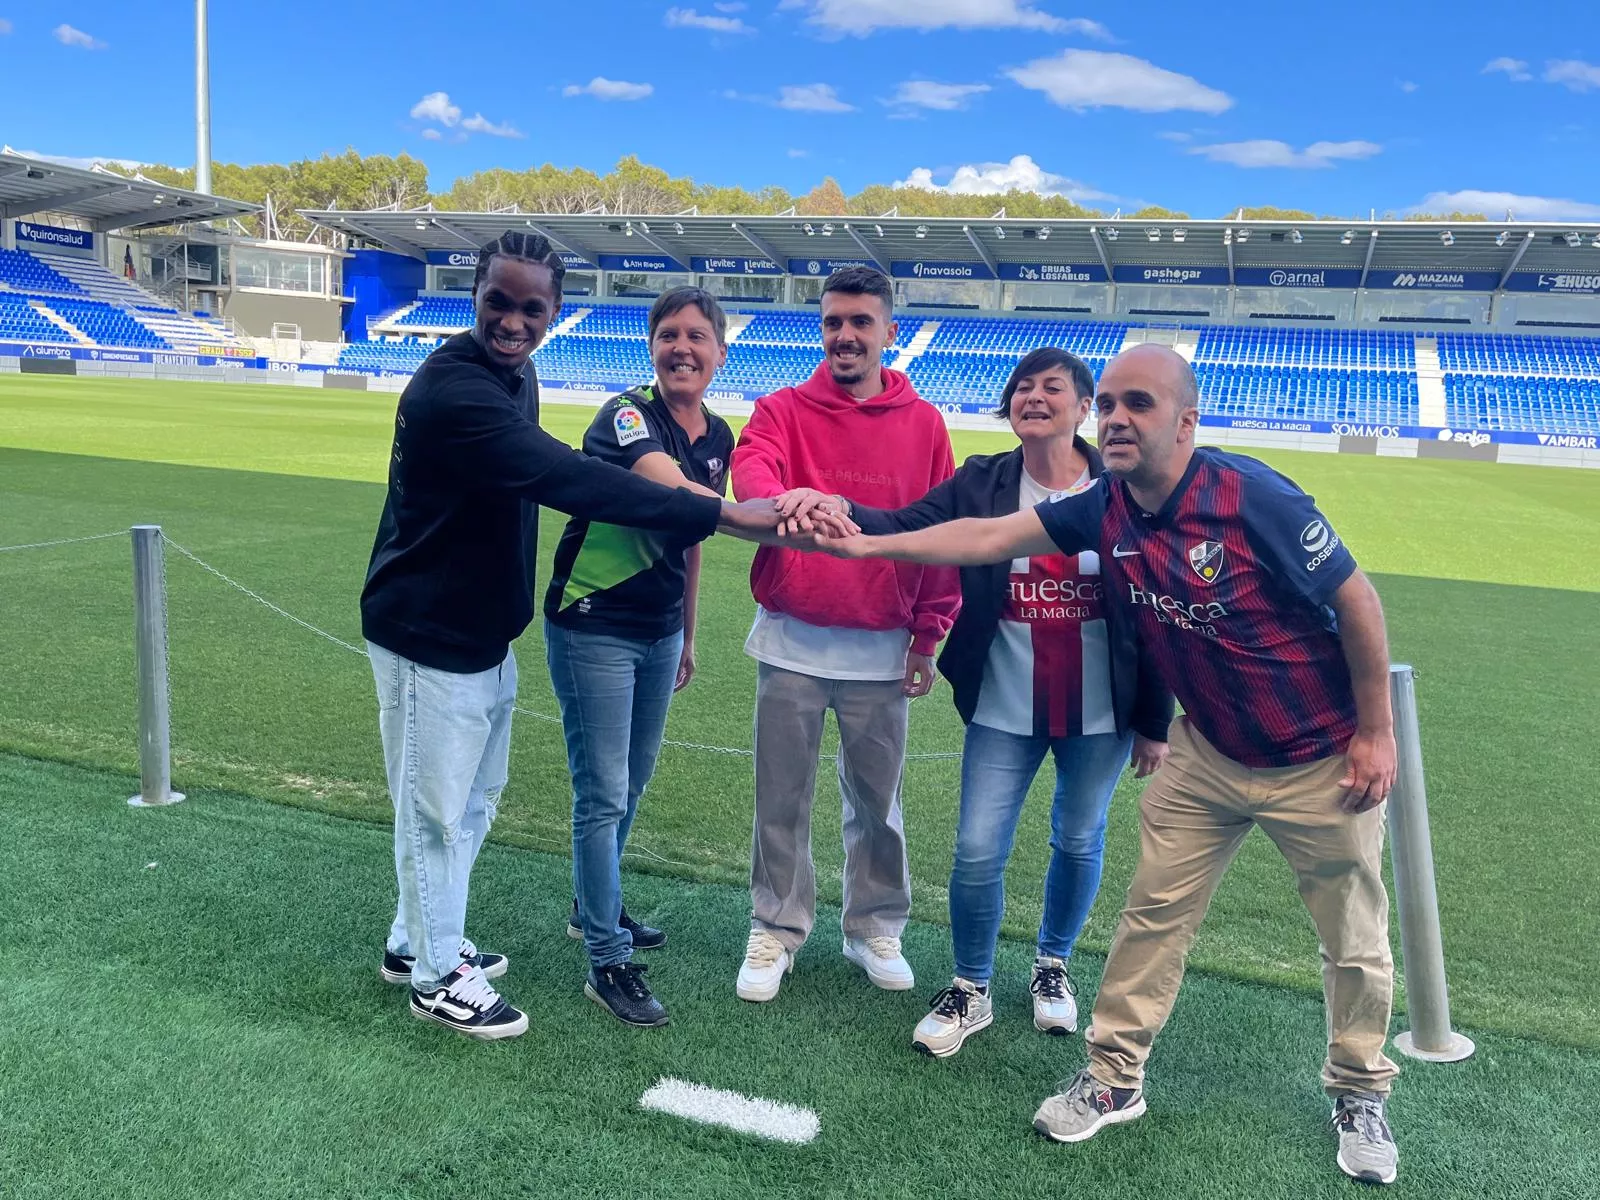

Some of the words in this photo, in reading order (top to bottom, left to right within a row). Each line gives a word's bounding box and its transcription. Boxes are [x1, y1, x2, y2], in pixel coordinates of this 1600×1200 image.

[449, 252, 480, 265] emb
[923, 266, 972, 276] navasola
[1041, 265, 1071, 273] GRUAS
[1143, 268, 1201, 280] gashogar
[1041, 272, 1090, 281] LOSFABLOS
[1286, 271, 1325, 283] arnal
[1418, 274, 1464, 283] MAZANA
[152, 353, 199, 366] BUENAVENTURA
[268, 362, 299, 373] IBOR
[1331, 423, 1399, 438] SOMMOS
[1549, 434, 1597, 448] AMBAR
[1306, 533, 1341, 572] COSEHIS
